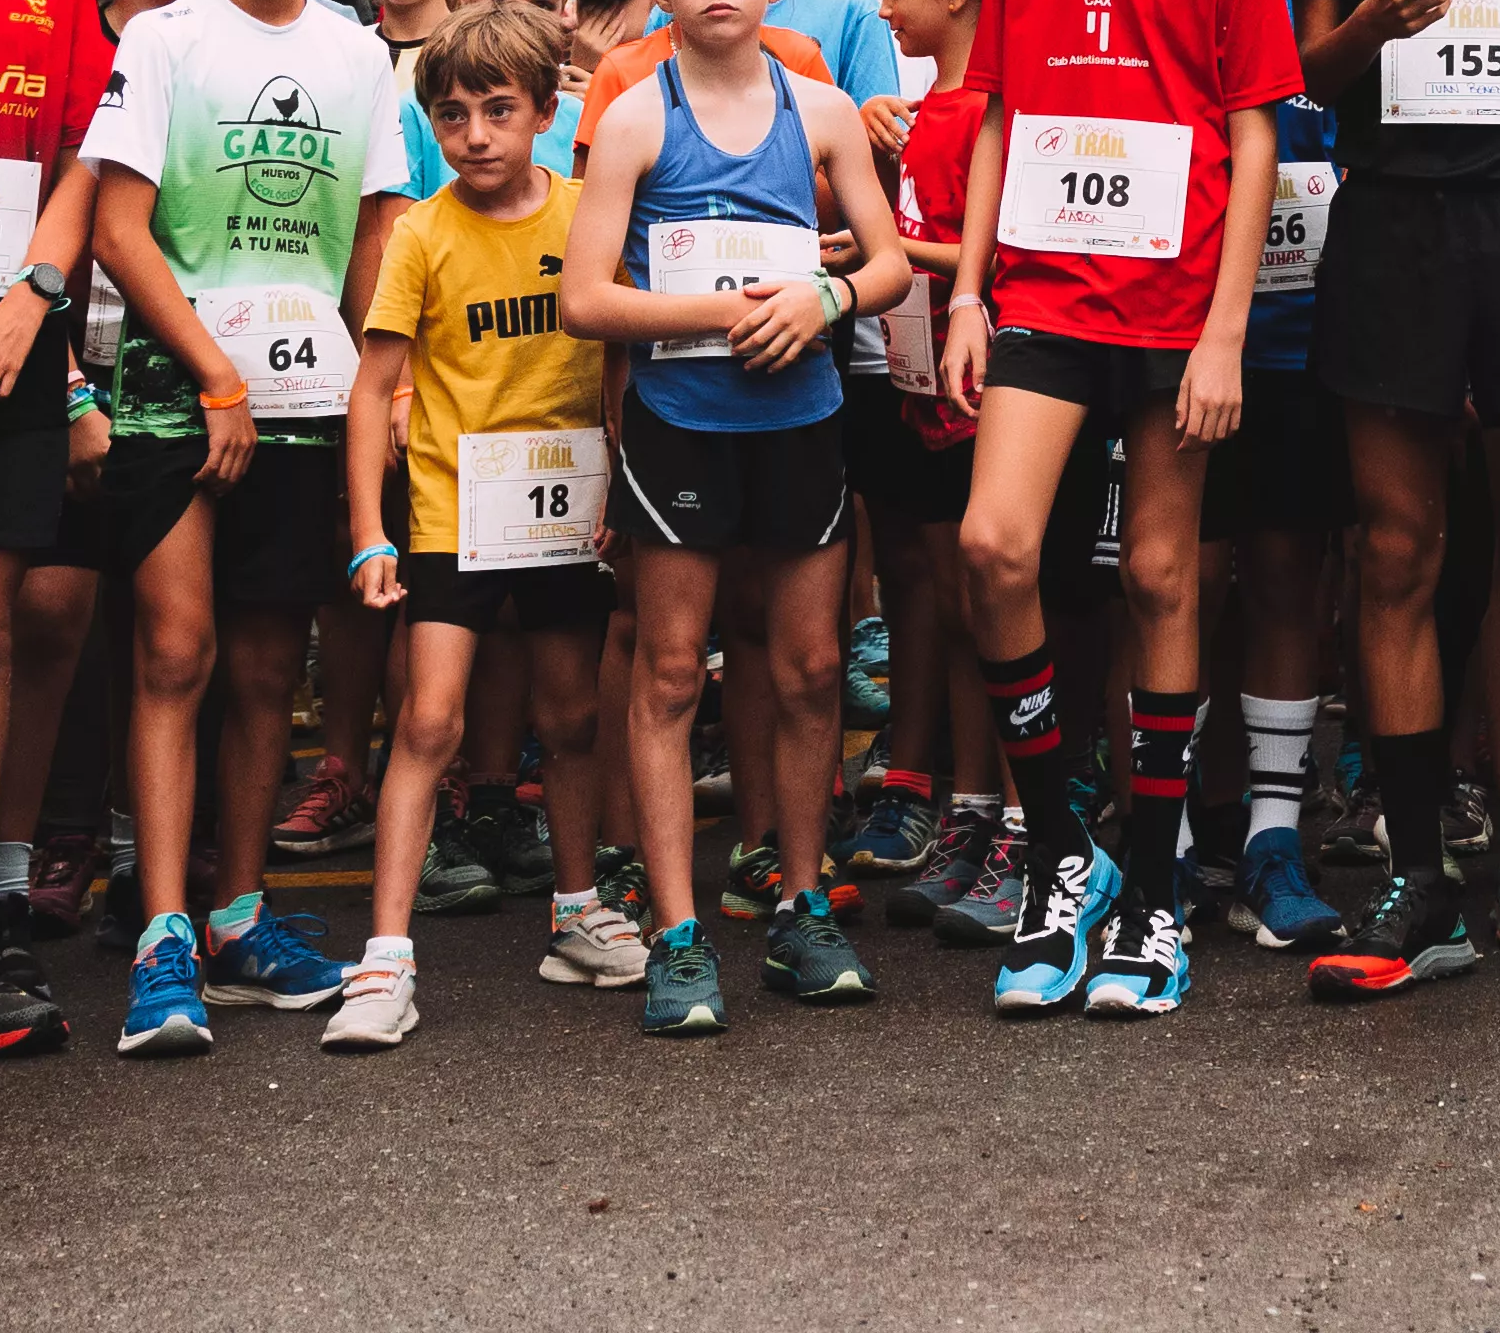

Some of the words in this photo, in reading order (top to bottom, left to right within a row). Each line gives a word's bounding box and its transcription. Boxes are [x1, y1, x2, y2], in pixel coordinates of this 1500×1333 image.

[223, 128, 336, 170] GAZOL
[1074, 132, 1128, 158] TRAIL
[261, 168, 301, 181] HUEVOS
[250, 178, 304, 201] ECOLÓGICO
[1060, 171, 1131, 208] 108
[246, 216, 267, 231] MI
[273, 218, 320, 238] GRANJA
[1055, 206, 1104, 224] AARON
[230, 237, 243, 250] A
[249, 237, 271, 251] TU
[275, 238, 310, 255] MESA
[714, 235, 768, 260] TRAIL
[267, 298, 316, 323] TRAIL
[466, 291, 564, 343] PUM
[268, 336, 318, 372] 64
[527, 445, 576, 470] TRAIL
[527, 483, 570, 519] 18
[1018, 687, 1053, 713] NIKE
[1020, 713, 1057, 735] AIR
